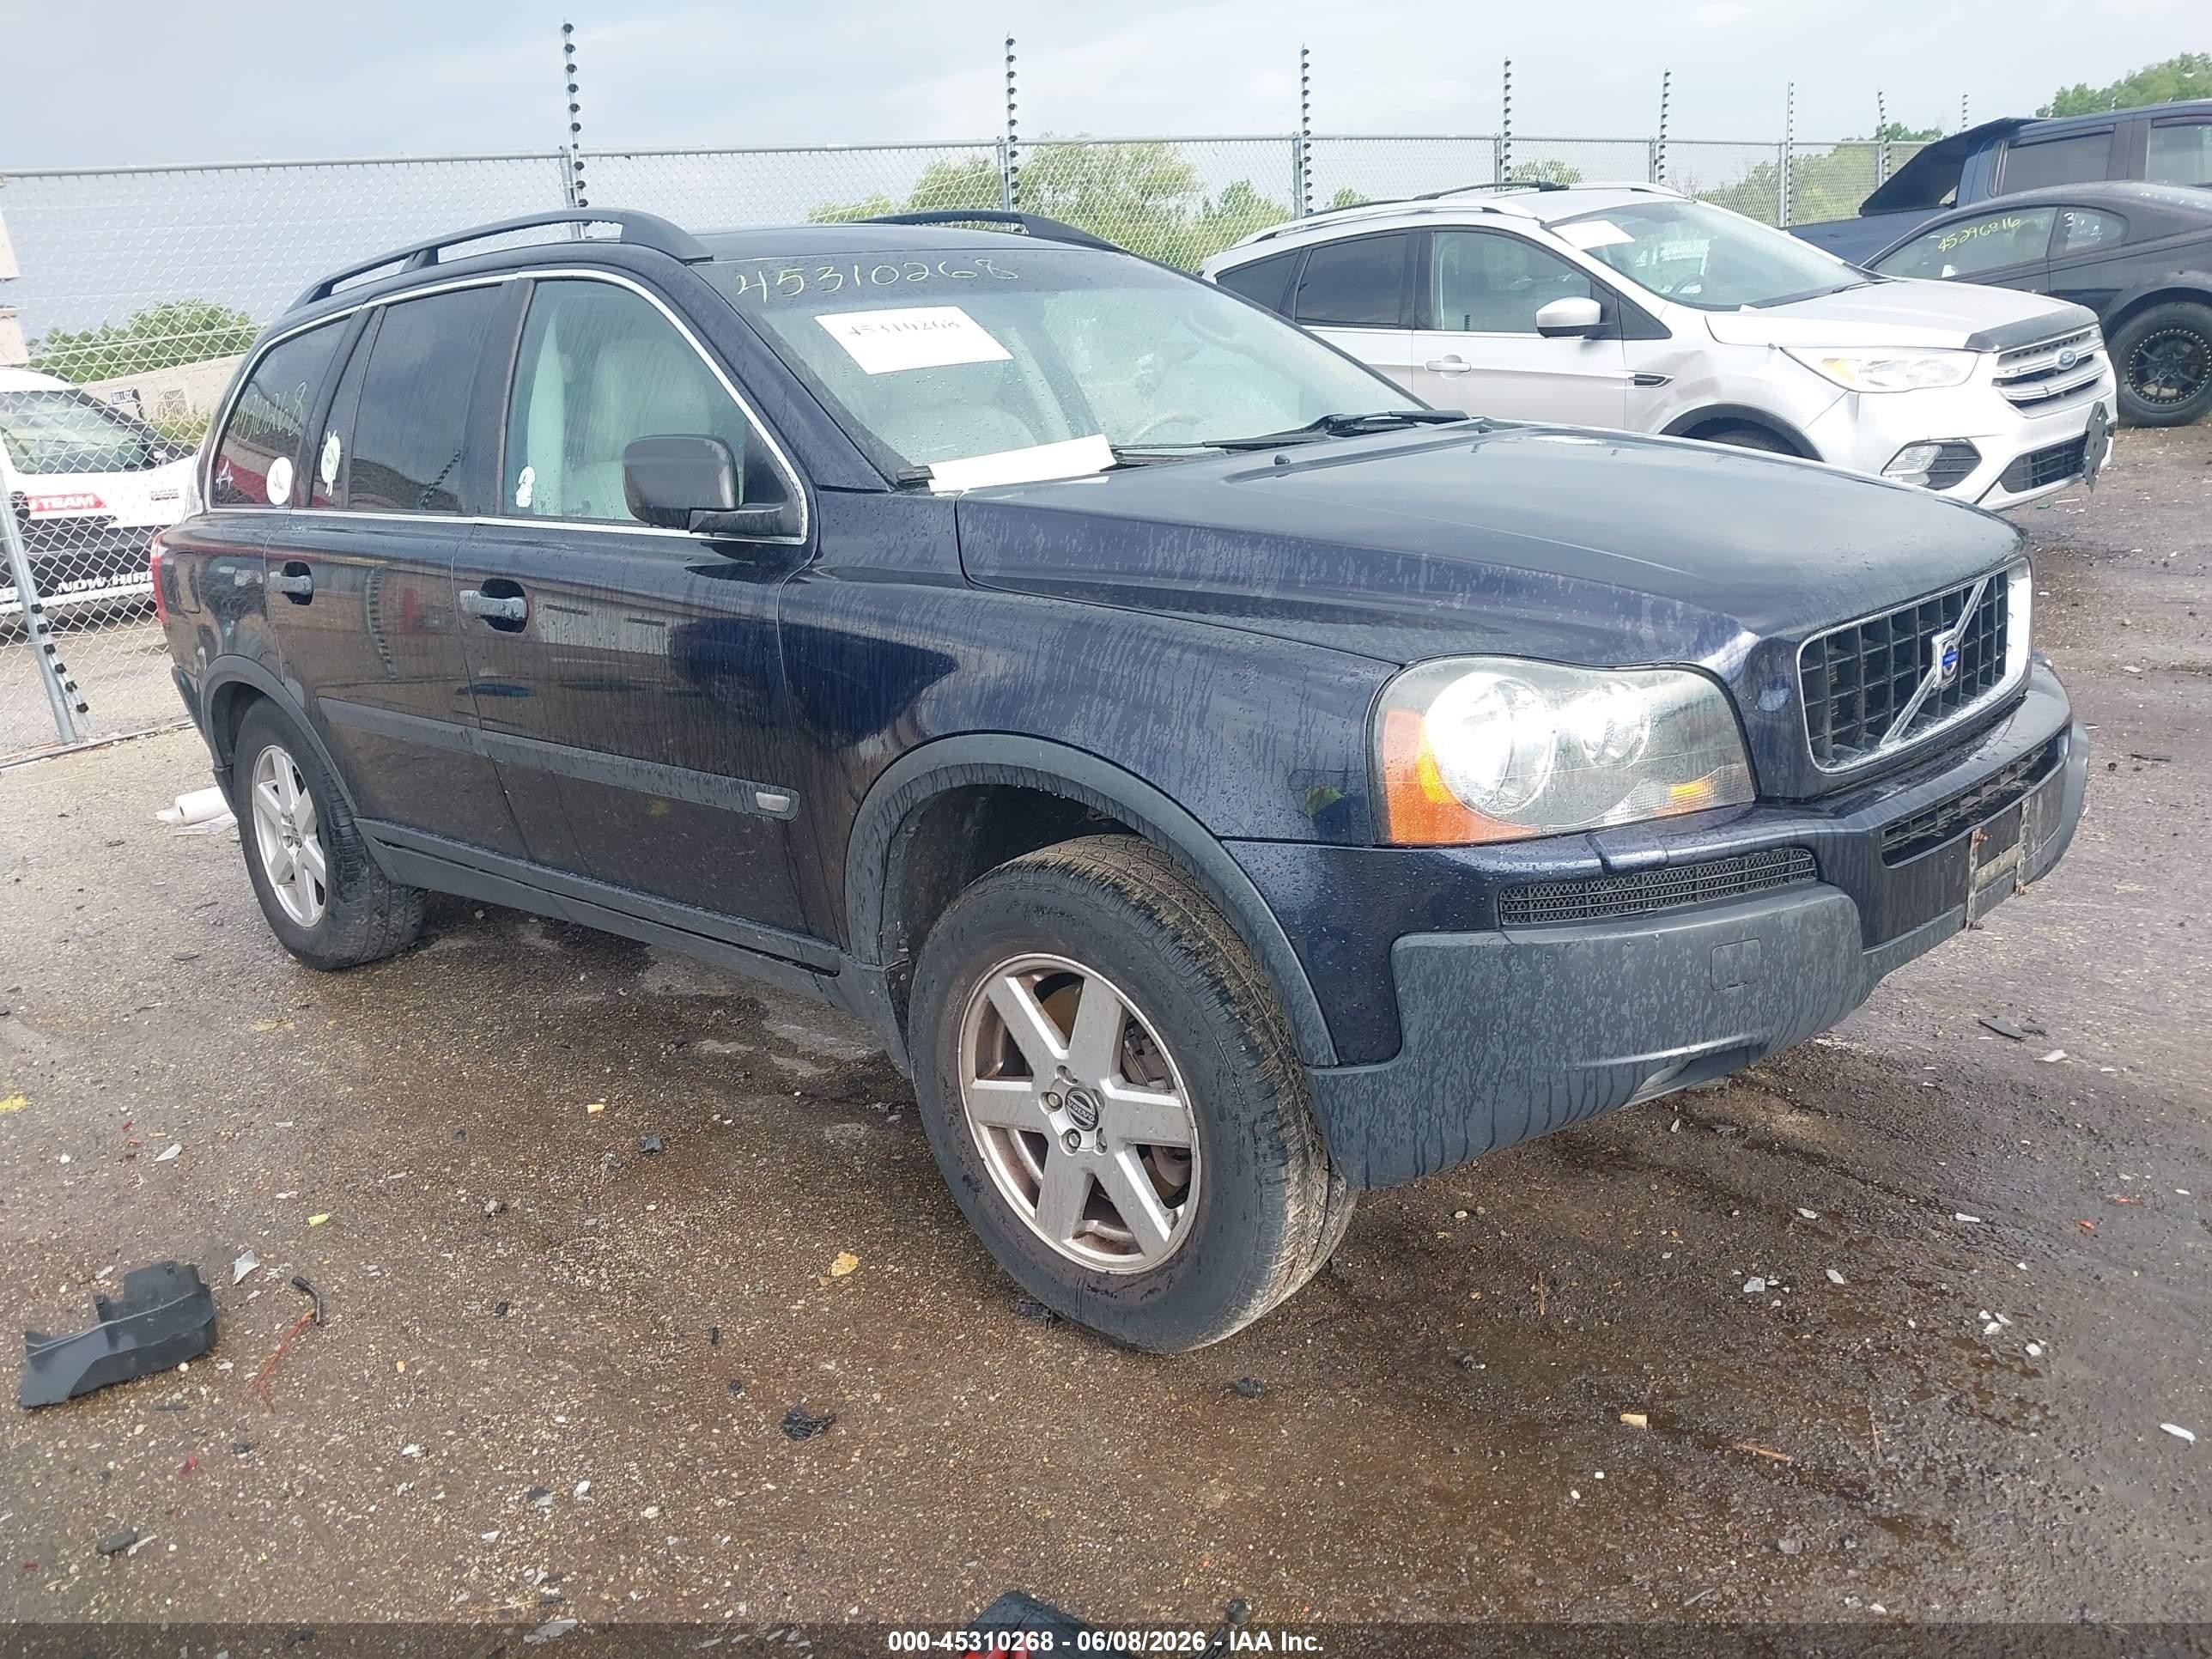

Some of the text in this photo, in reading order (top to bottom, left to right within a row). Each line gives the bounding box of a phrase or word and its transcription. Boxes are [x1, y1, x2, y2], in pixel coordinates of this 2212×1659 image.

[1938, 216, 2021, 252] 45296816
[737, 258, 1018, 302] 45310268
[41, 495, 95, 509] TEAM
[58, 576, 106, 593] NOW
[1067, 1099, 1096, 1121] VOLVO
